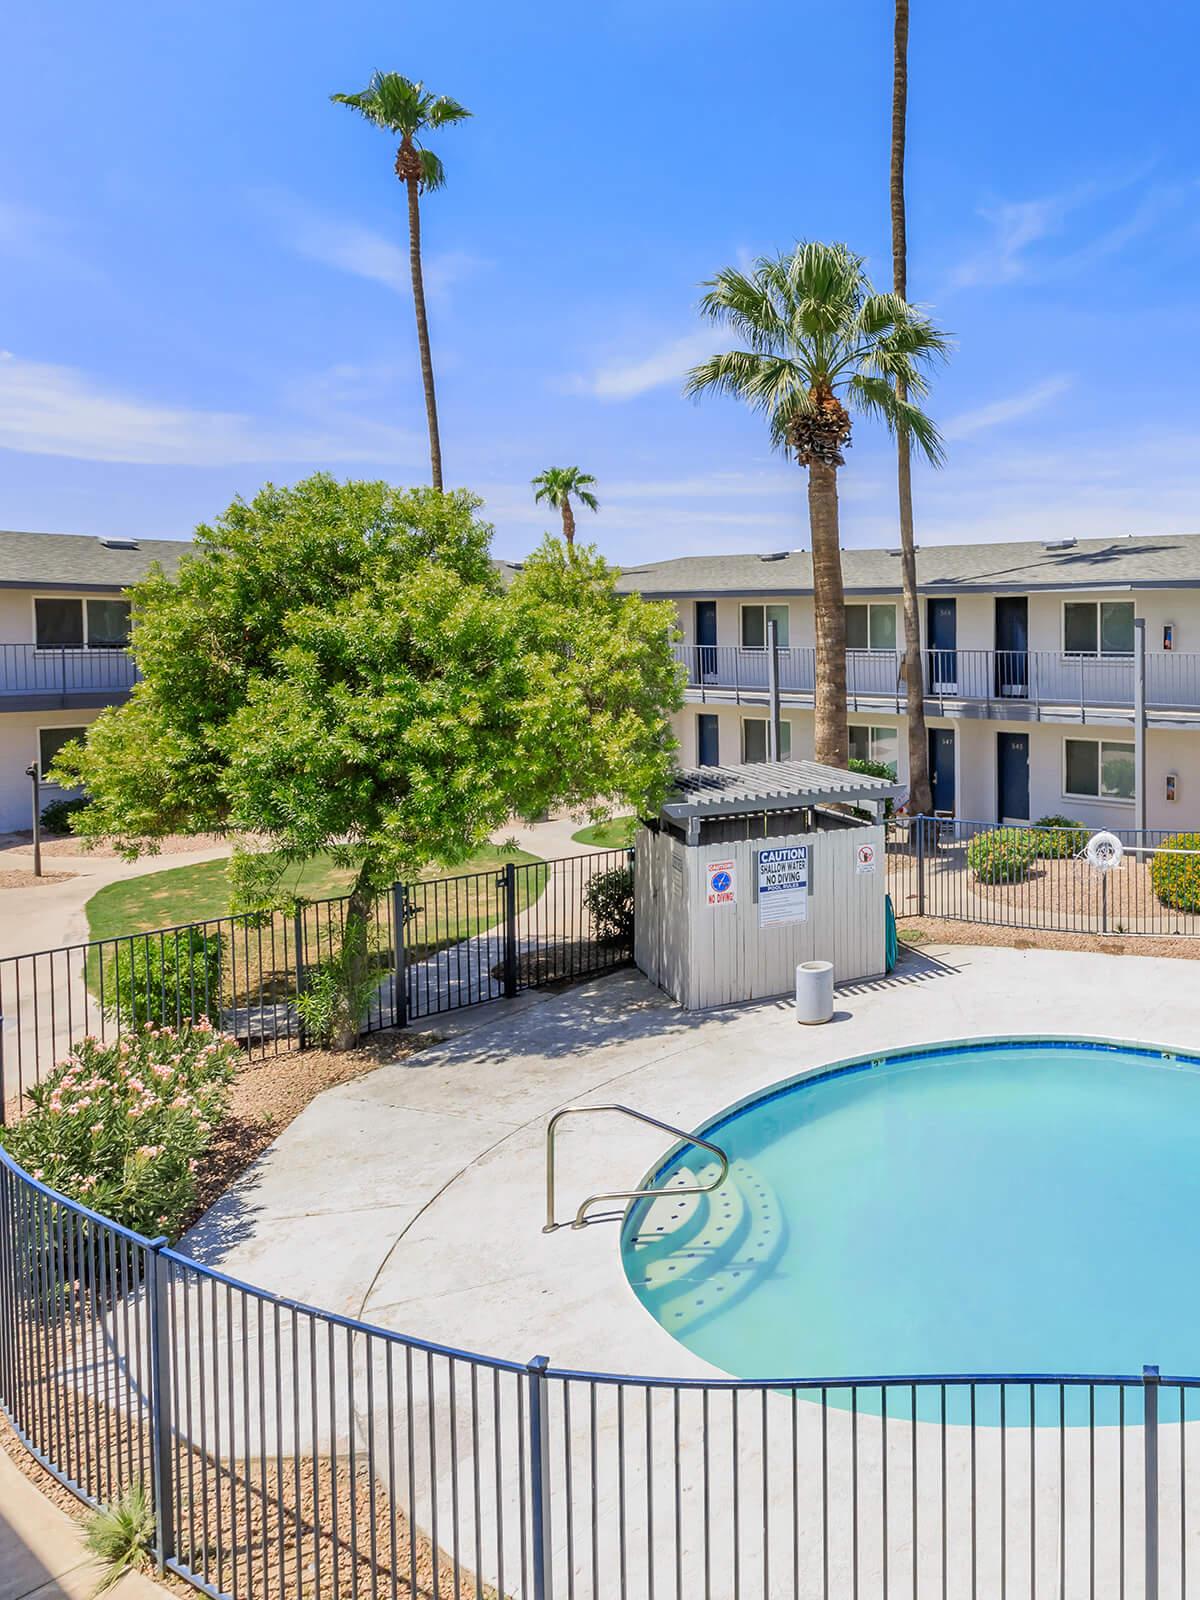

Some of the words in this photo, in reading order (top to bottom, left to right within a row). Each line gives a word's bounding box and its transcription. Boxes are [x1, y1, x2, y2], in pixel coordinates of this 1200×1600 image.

[761, 847, 805, 863] CAUTION
[760, 862, 786, 875] SHALLOW
[787, 861, 806, 872] WATER
[766, 874, 776, 885] NO
[778, 871, 801, 884] DIVING
[768, 884, 782, 892] POOL
[708, 894, 715, 904] NO
